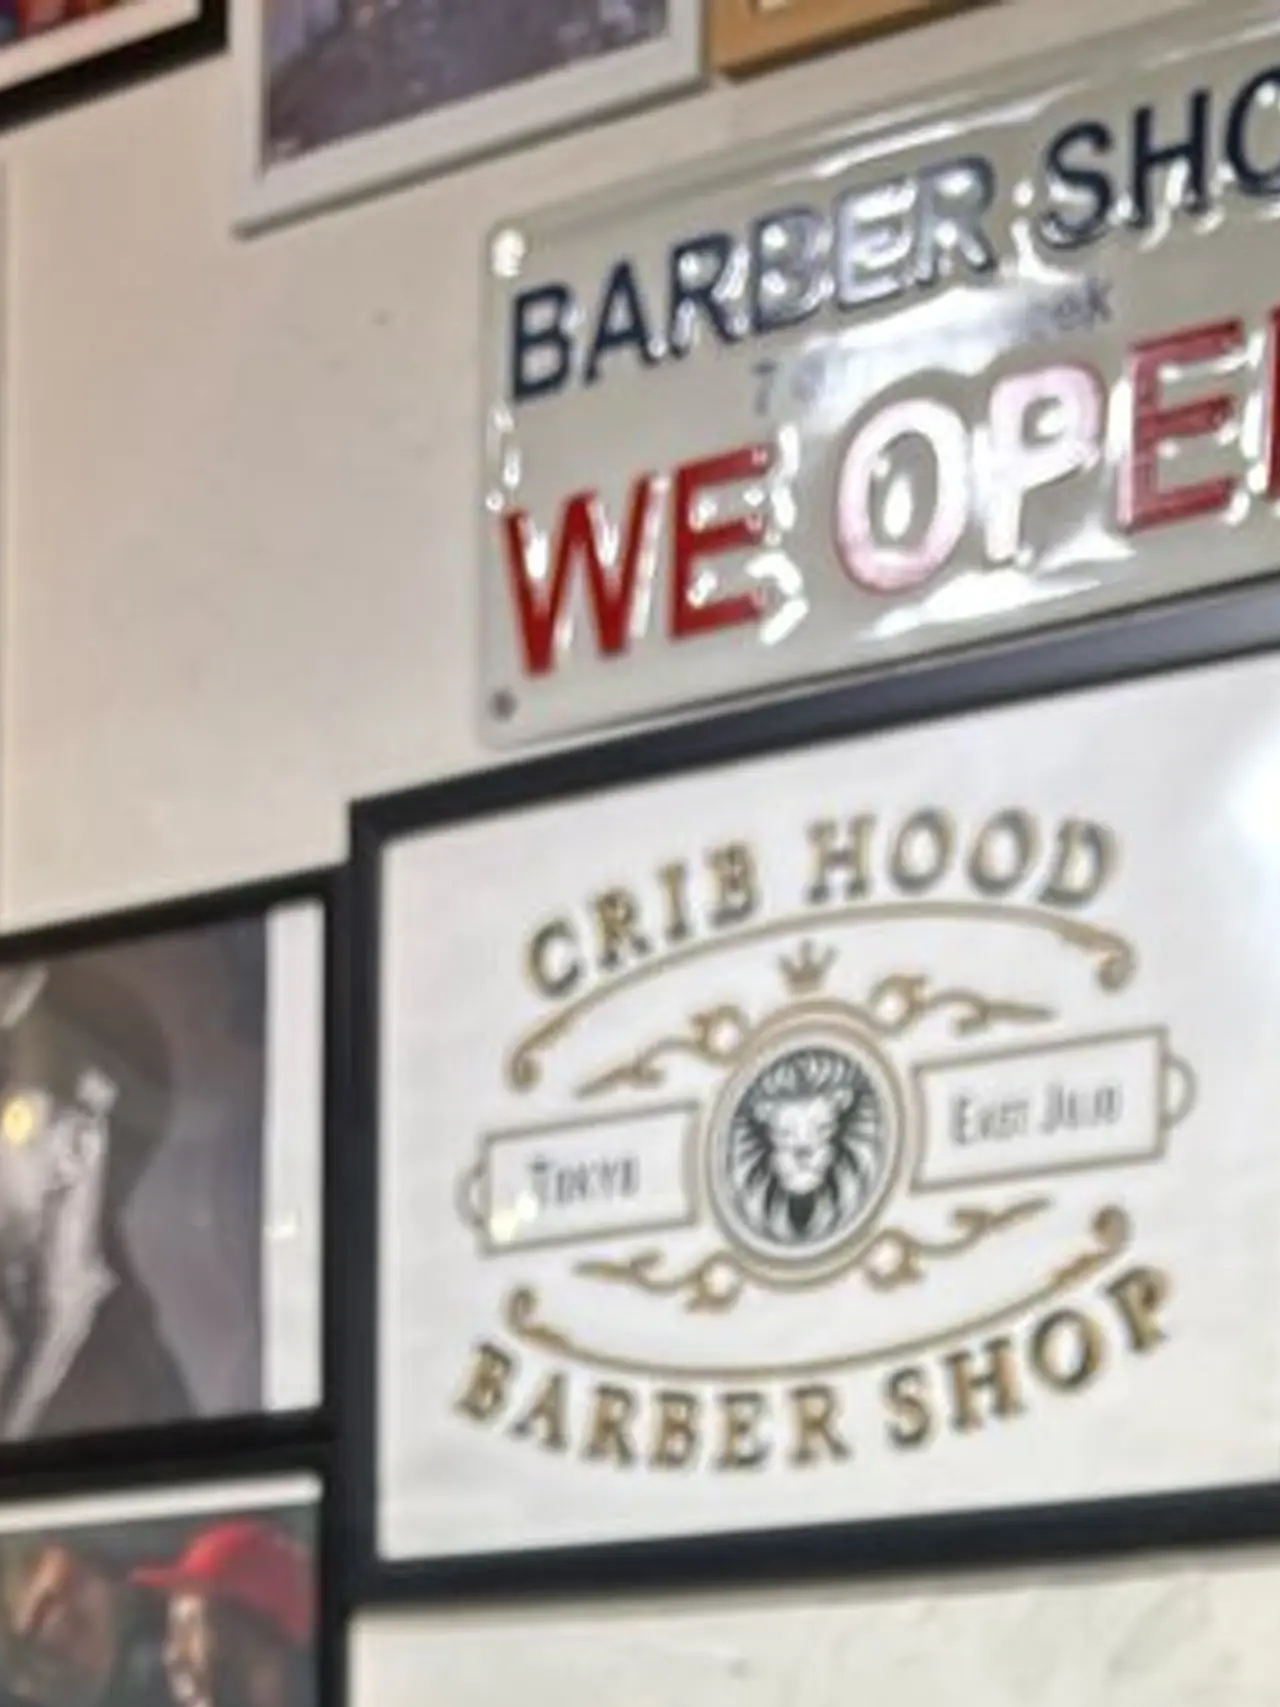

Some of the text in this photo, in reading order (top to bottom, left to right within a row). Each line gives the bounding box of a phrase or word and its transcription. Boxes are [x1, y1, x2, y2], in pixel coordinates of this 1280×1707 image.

[510, 156, 998, 400] BARBER
[502, 441, 771, 678] WE
[526, 804, 1121, 1000] CRIB HOOD
[458, 1265, 1172, 1472] BARBER SHOP
